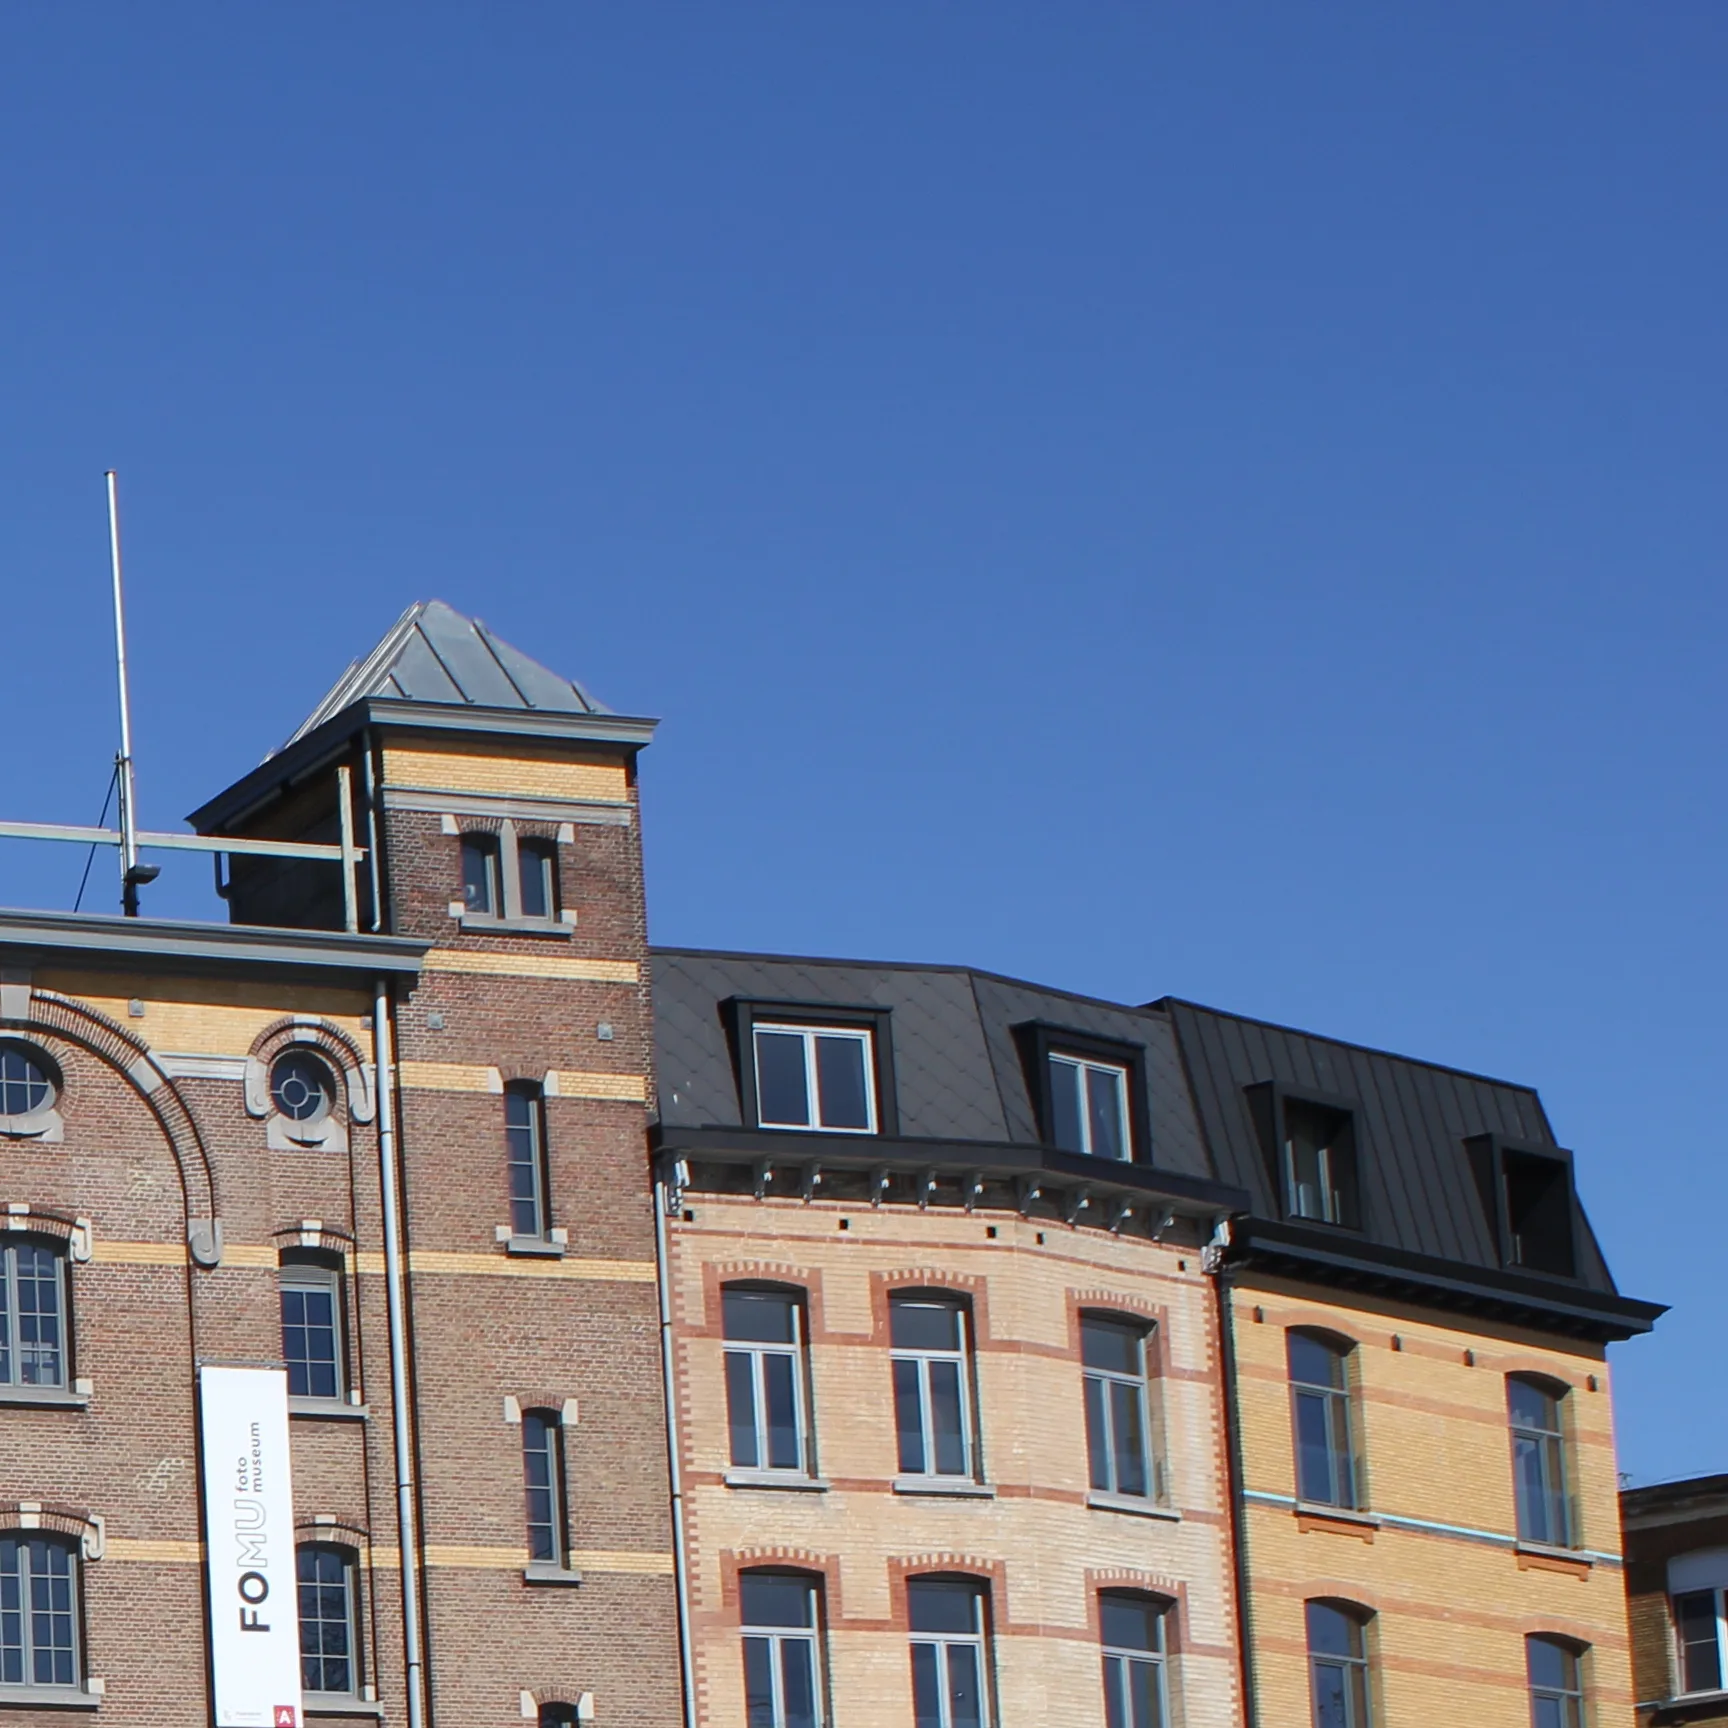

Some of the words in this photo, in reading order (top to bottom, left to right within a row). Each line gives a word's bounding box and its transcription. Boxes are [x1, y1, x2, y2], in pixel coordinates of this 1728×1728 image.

[235, 1455, 248, 1493] foto
[249, 1421, 263, 1494] museum
[233, 1499, 272, 1633] FOMU
